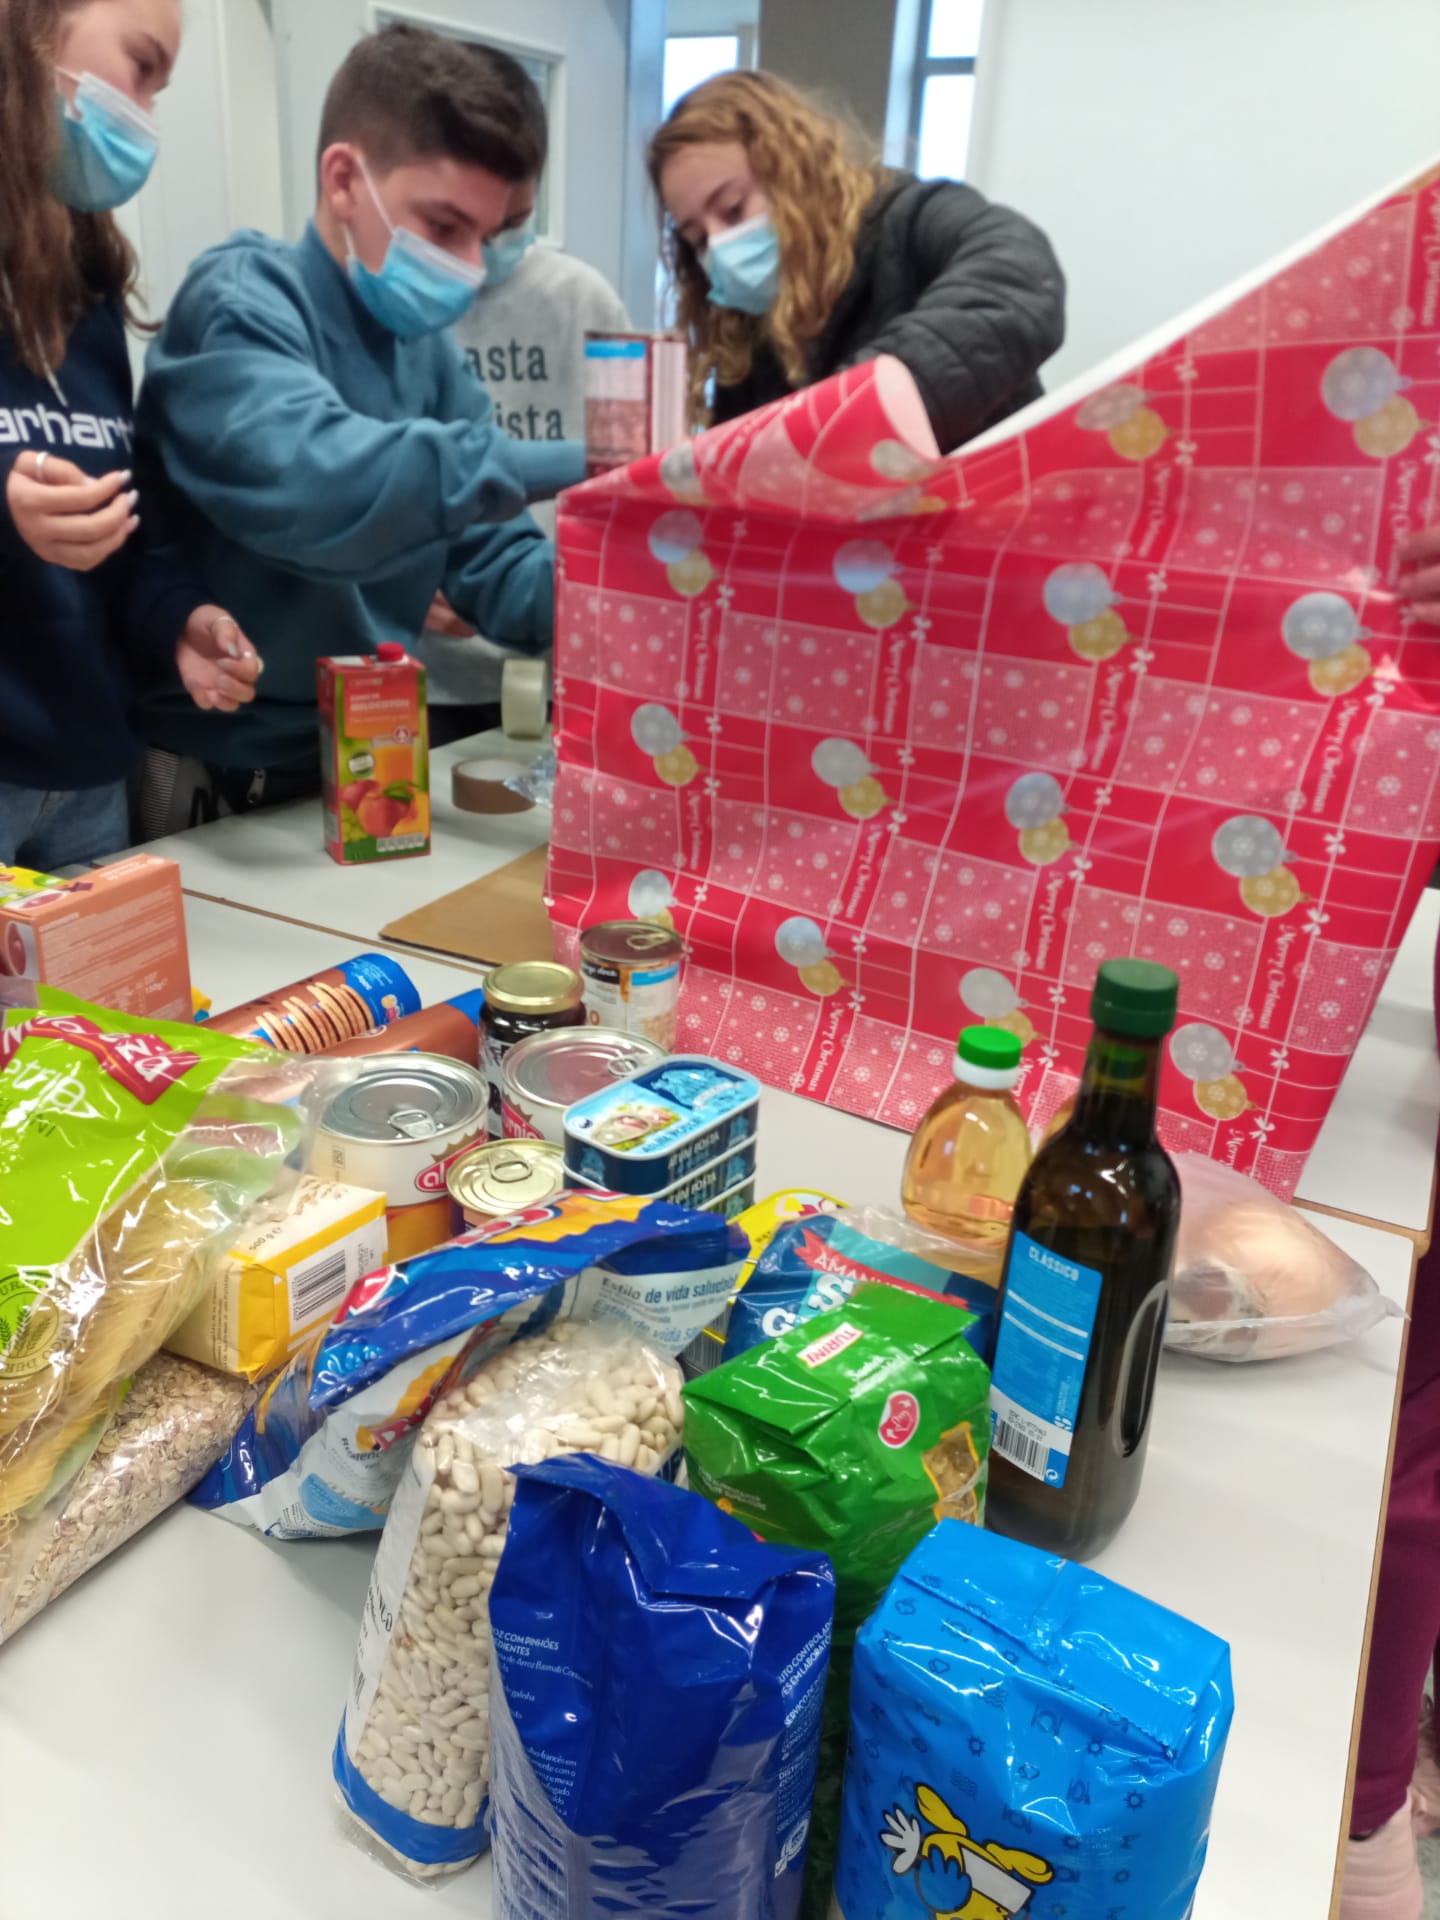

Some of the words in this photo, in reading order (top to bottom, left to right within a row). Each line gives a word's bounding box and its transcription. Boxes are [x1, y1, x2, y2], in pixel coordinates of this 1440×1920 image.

[822, 1002, 844, 1039] Merry
[808, 1039, 834, 1092] Christmas
[644, 1290, 662, 1304] de
[665, 1285, 690, 1302] vida
[804, 1329, 857, 1363] TURINI
[503, 1632, 525, 1646] COM
